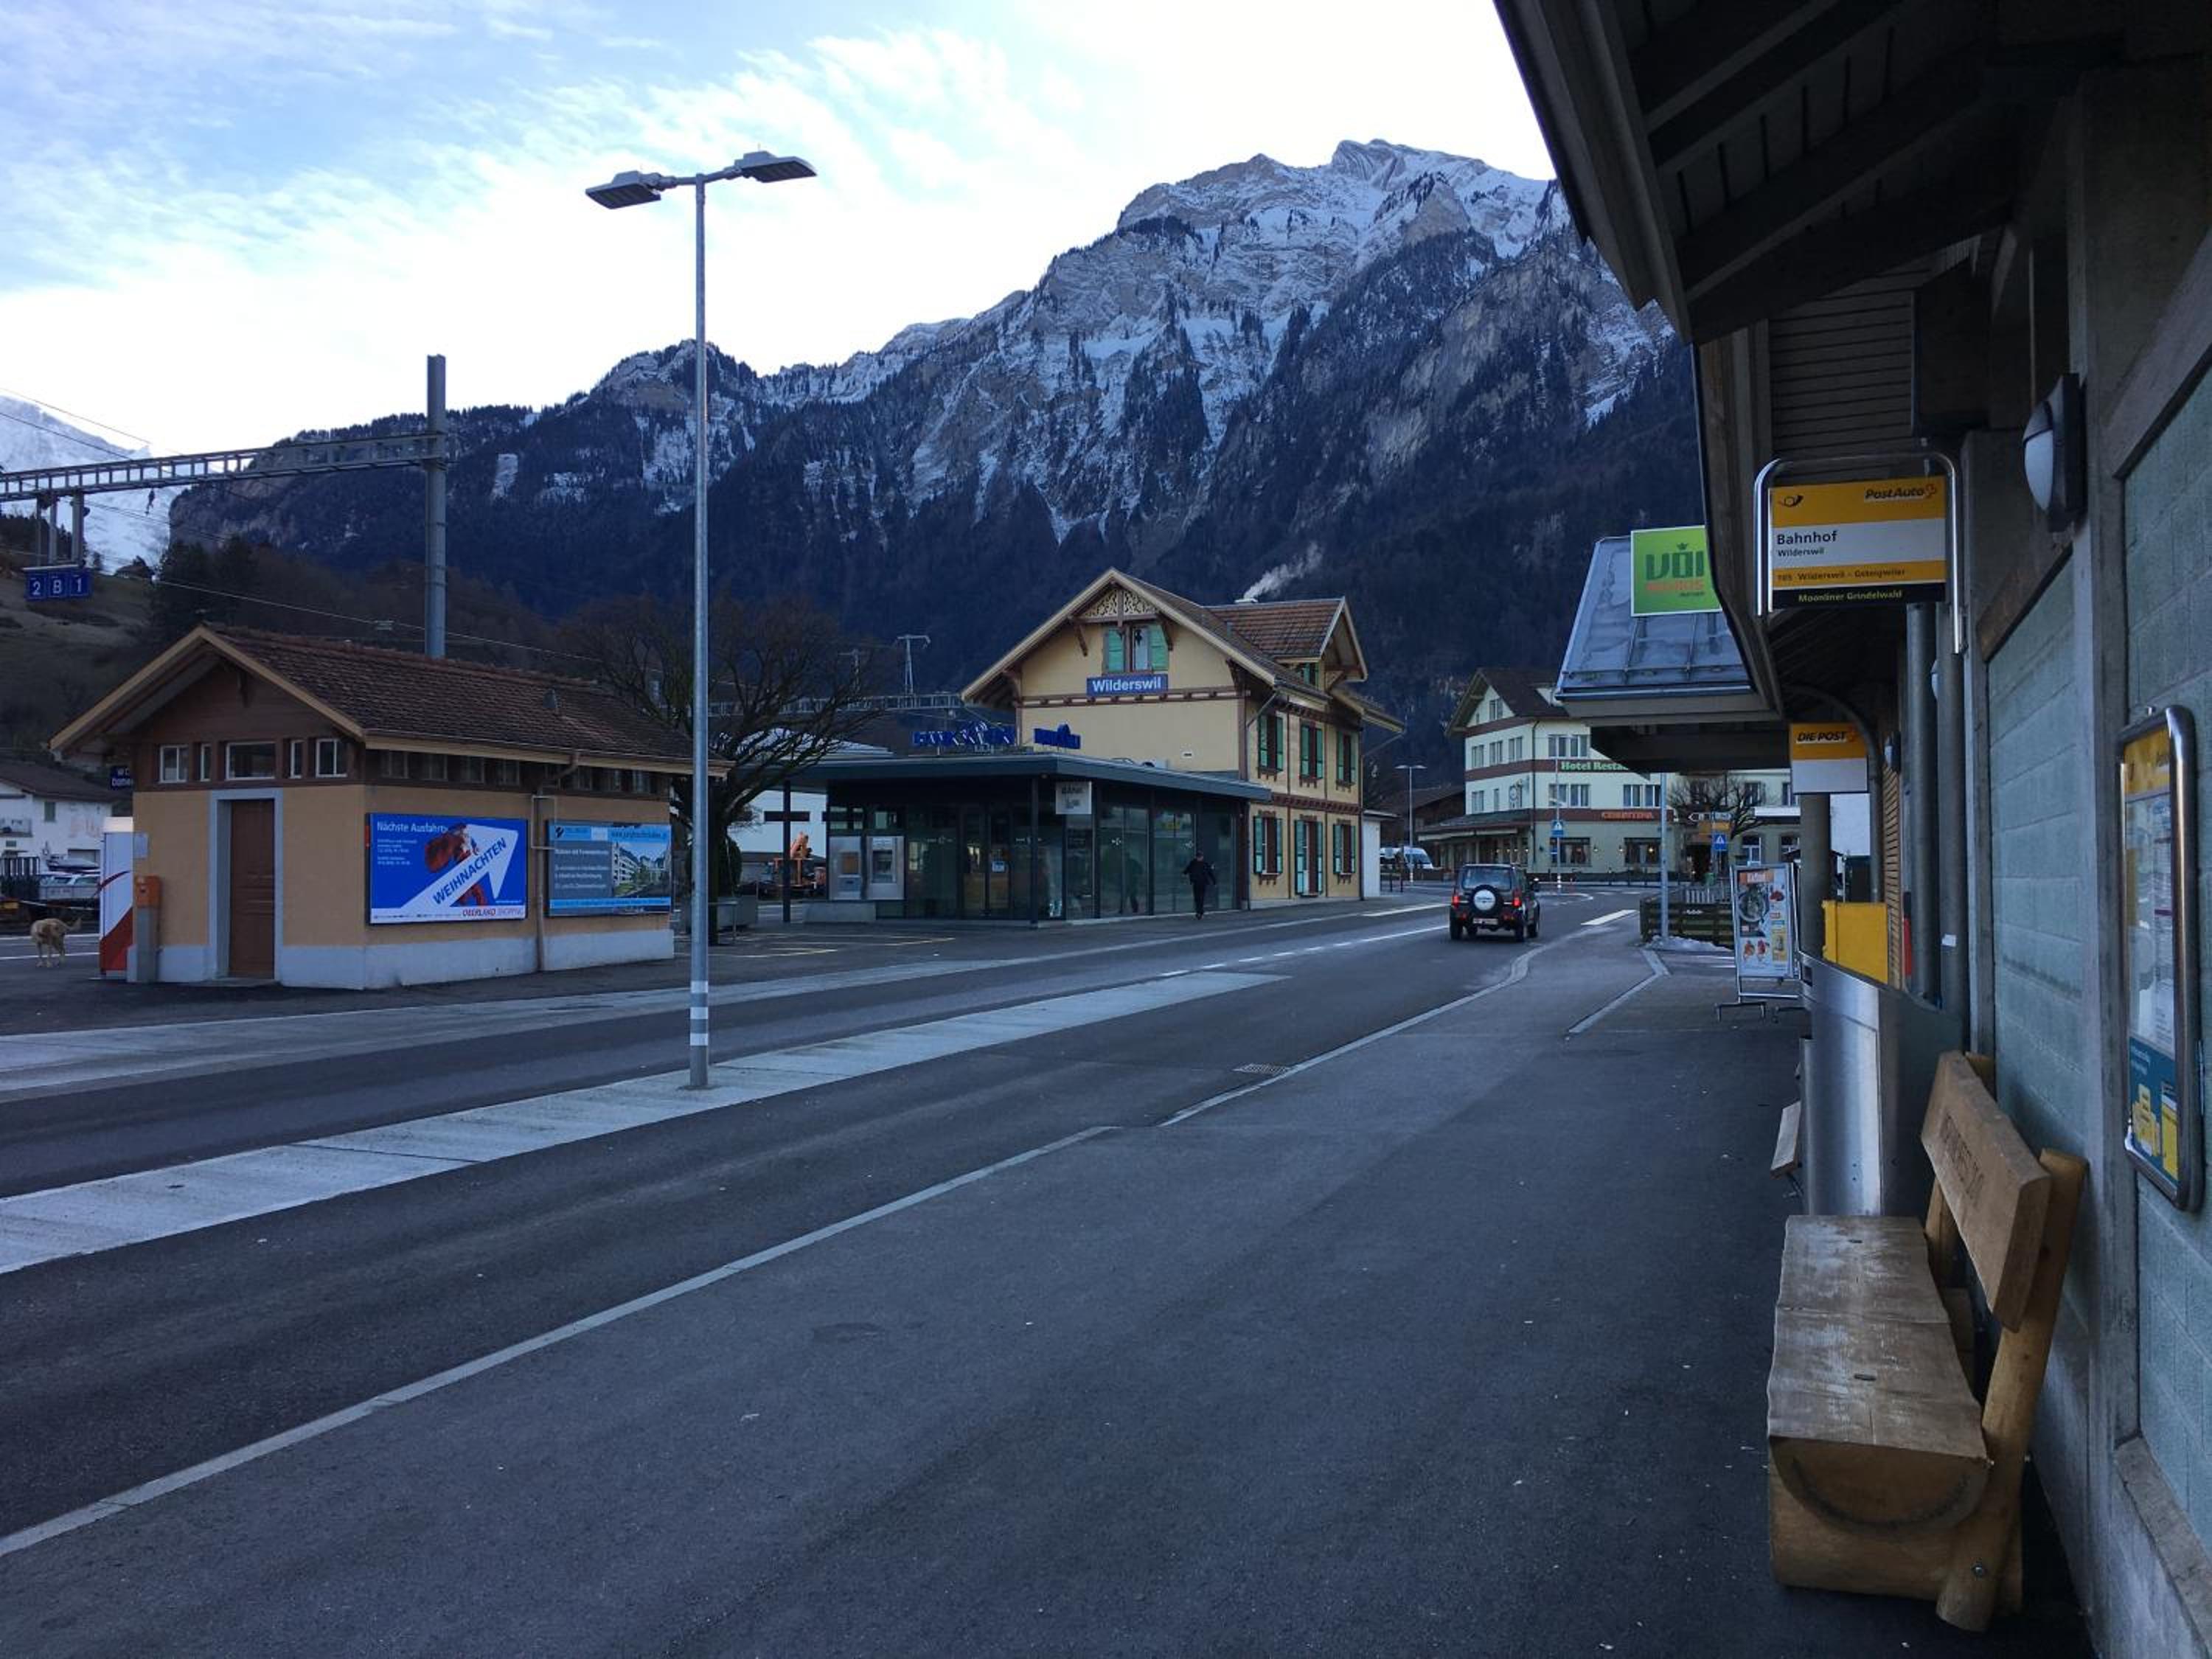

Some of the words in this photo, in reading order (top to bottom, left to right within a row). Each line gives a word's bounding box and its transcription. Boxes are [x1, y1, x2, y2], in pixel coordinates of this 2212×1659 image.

[1865, 487, 1924, 499] PostAuto
[1776, 530, 1837, 545] Bahnhof
[1777, 547, 1825, 557] Wilderswil
[1797, 570, 1845, 580] Wilderswil
[75, 578, 83, 593] 1
[1798, 593, 1845, 602] Moonliner
[1846, 590, 1902, 599] Grindelwald
[1092, 676, 1162, 693] Wilderswil
[1797, 731, 1817, 741] DIE
[1818, 731, 1846, 741] POST
[1560, 761, 1591, 771] Hotel
[377, 821, 409, 832] Nächste
[432, 838, 507, 905] WEIHNACHTEN
